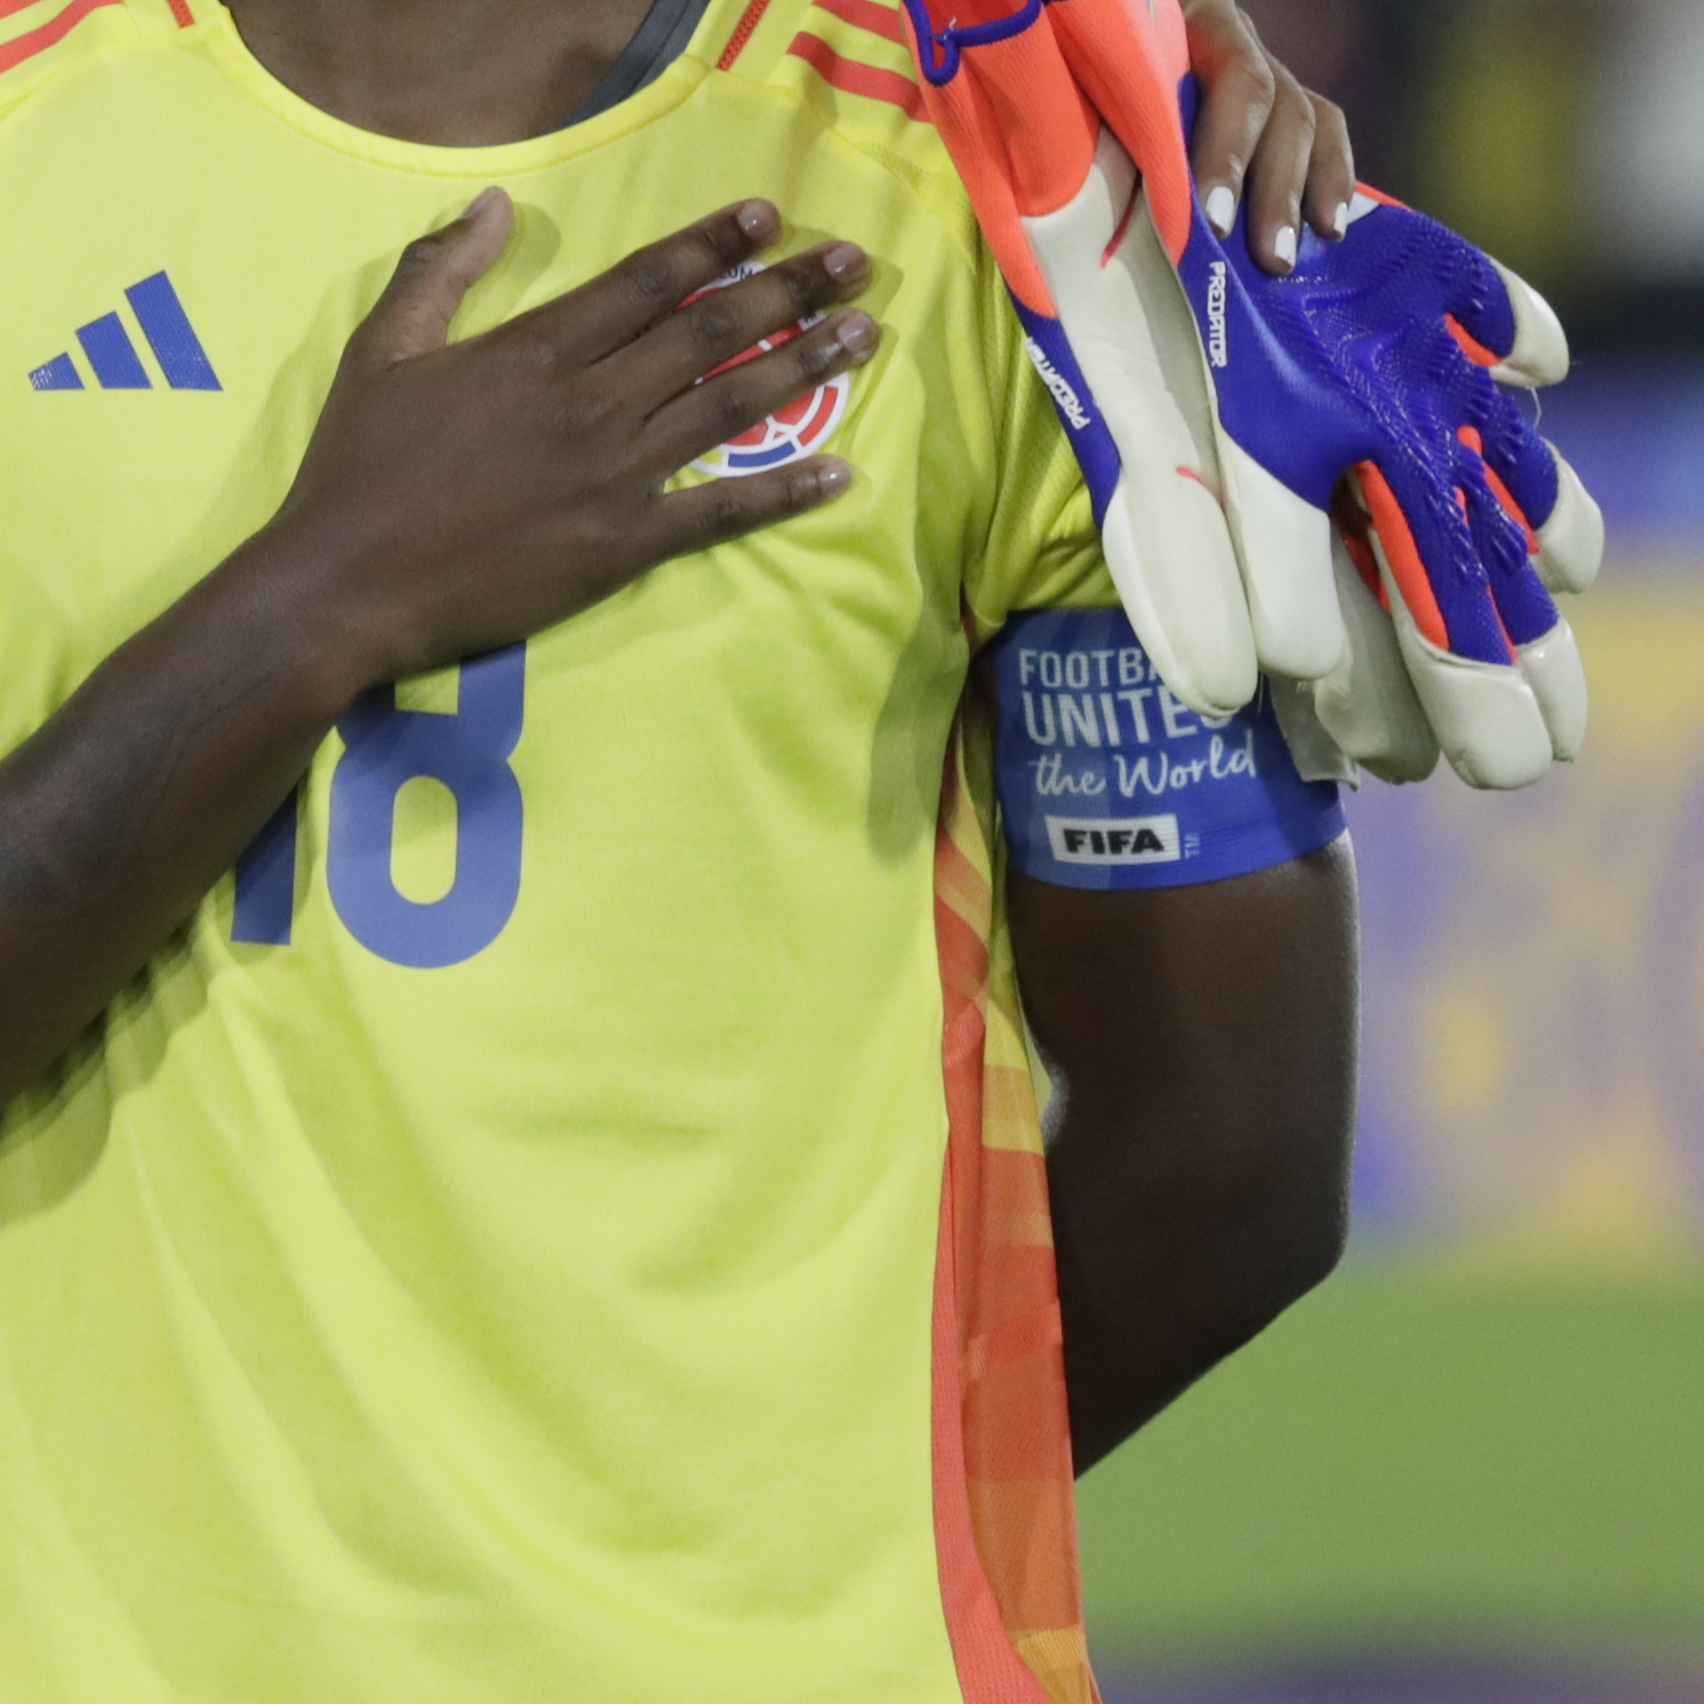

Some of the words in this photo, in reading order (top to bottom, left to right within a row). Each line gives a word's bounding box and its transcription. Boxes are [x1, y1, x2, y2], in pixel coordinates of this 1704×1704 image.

[1207, 261, 1227, 368] PREDATOR
[1022, 688, 1233, 748] UNITE
[1028, 752, 1107, 798] the
[1113, 729, 1257, 798] World
[1062, 828, 1165, 855] FIFA
